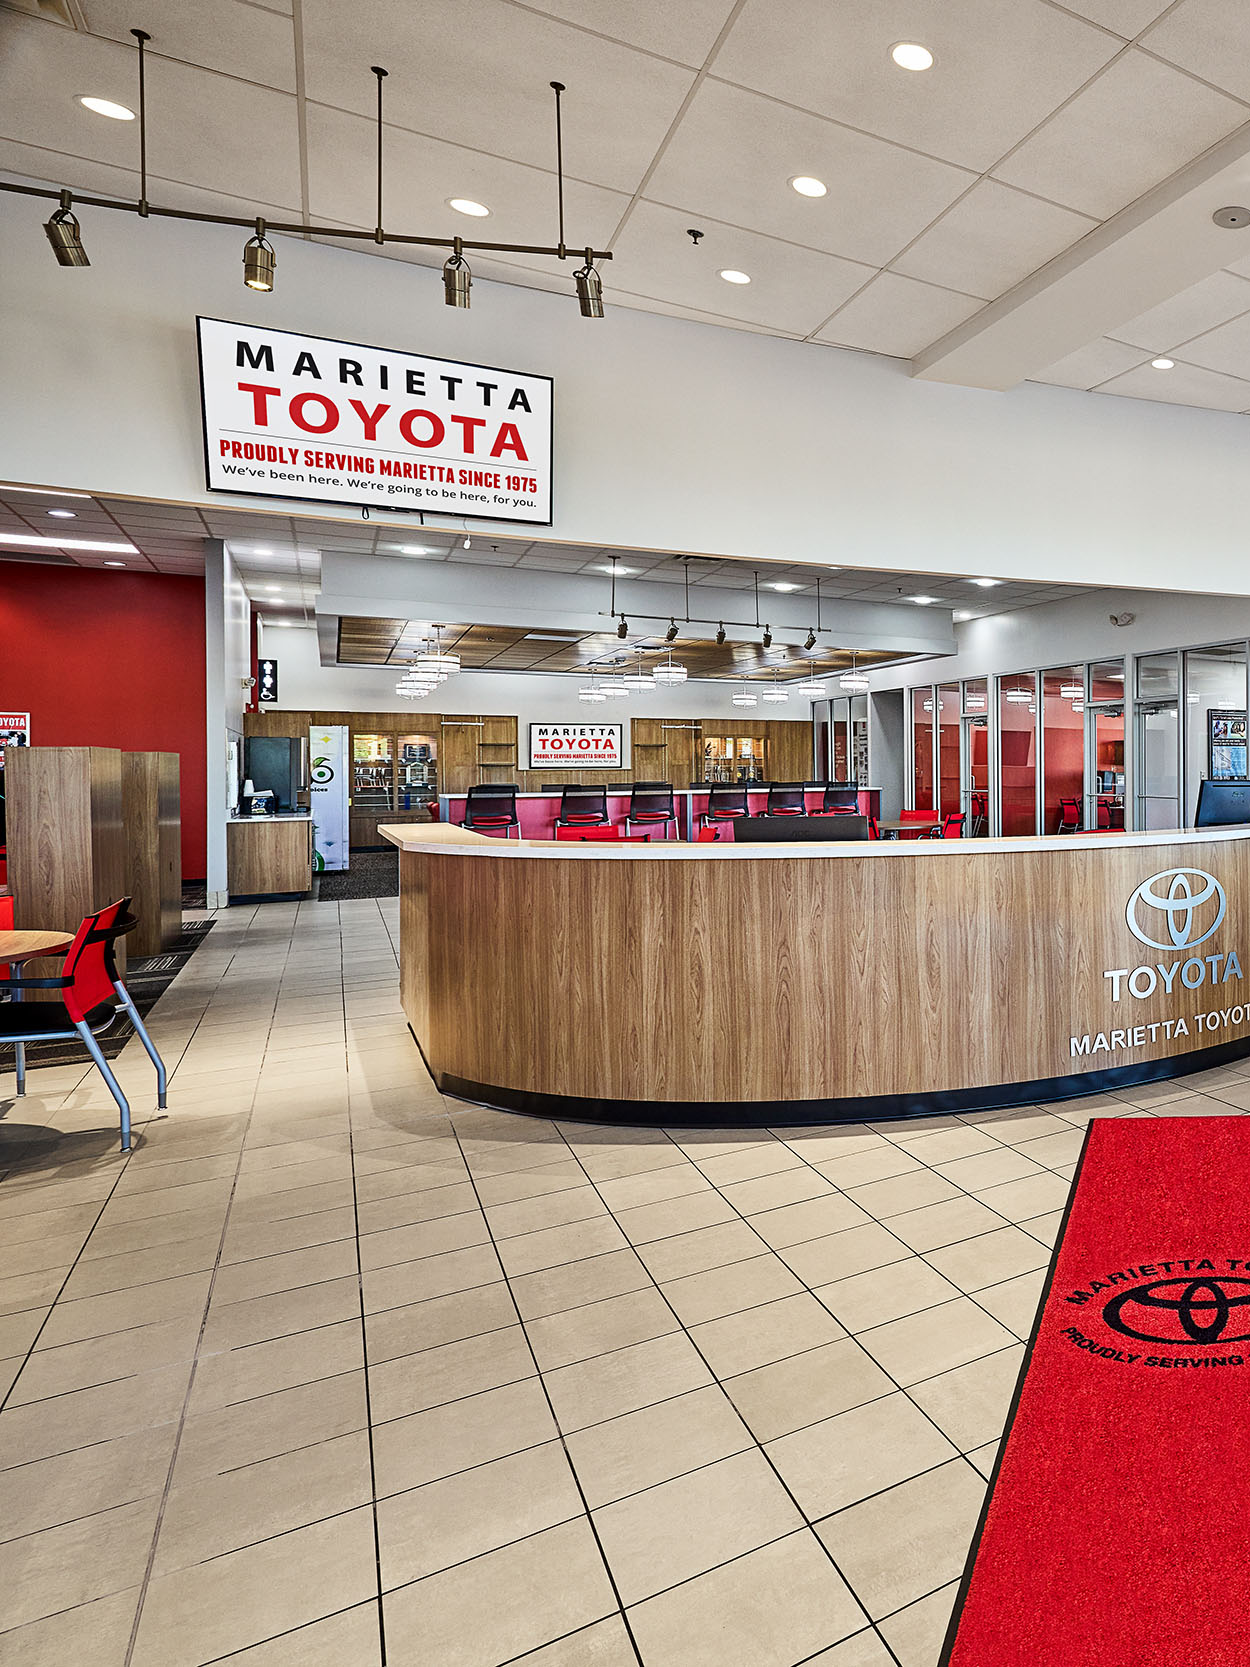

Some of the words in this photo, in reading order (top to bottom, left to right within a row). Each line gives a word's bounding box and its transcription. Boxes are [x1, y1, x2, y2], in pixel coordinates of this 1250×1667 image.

[236, 340, 532, 413] MARIETTA
[238, 382, 529, 461] TOYOTA
[220, 439, 299, 465] PROUDLY
[304, 449, 375, 475] SERVING
[379, 459, 455, 484] MARIETTA
[459, 469, 501, 489] SINCE
[505, 475, 538, 493] 1975
[222, 464, 265, 477] We've
[270, 470, 304, 482] been
[309, 474, 344, 486] here.
[347, 478, 384, 490] We're
[388, 484, 422, 497] going
[426, 488, 438, 496] to
[442, 489, 456, 498] be
[460, 491, 490, 503] here,
[493, 495, 510, 504] for
[512, 499, 537, 508] you.
[0, 717, 25, 727] OYOTA
[538, 728, 615, 736] MARIETTA
[538, 738, 614, 750] TOYOTA
[1103, 951, 1243, 1002] TOYOTA
[1070, 1018, 1189, 1057] MARIETTA
[1064, 1259, 1215, 1305] MARIETTA
[1060, 1326, 1141, 1364] PROUDLY
[1144, 1355, 1244, 1368] SERVING
